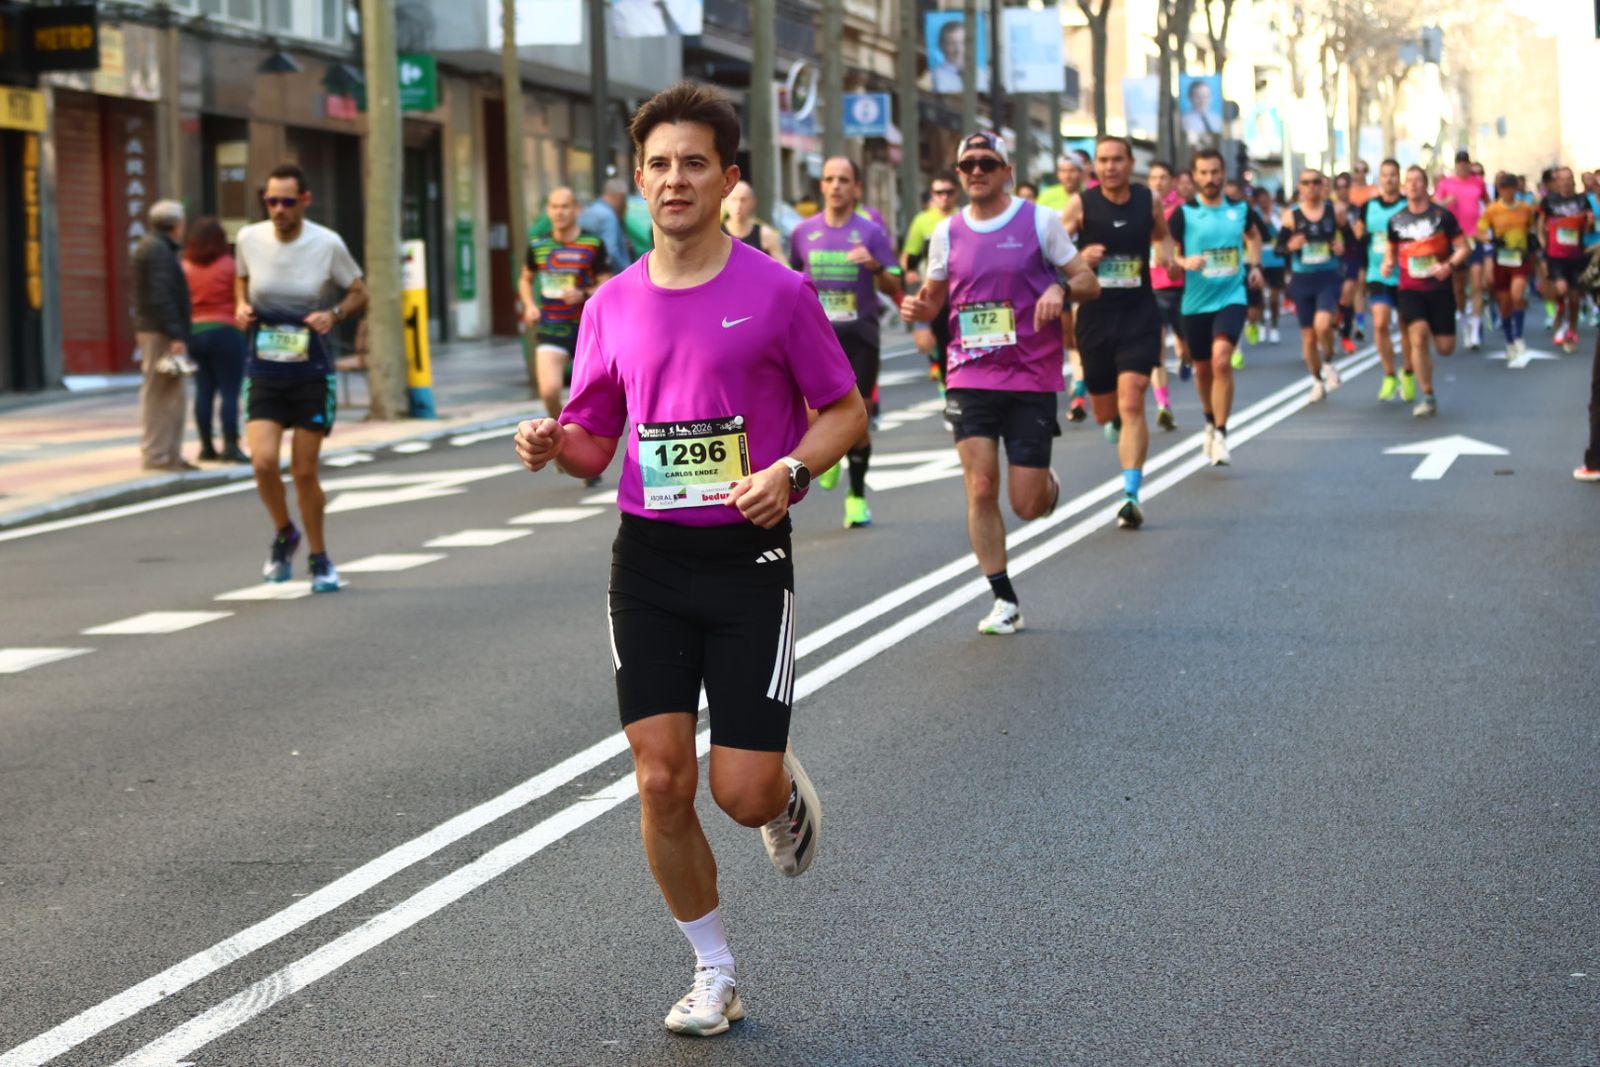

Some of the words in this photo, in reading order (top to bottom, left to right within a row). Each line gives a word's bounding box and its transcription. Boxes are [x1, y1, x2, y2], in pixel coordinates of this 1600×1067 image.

[972, 312, 998, 325] 472
[691, 422, 712, 433] 2026
[655, 440, 726, 466] 1296
[665, 470, 693, 478] CARLOS
[694, 468, 719, 476] ENDEZ
